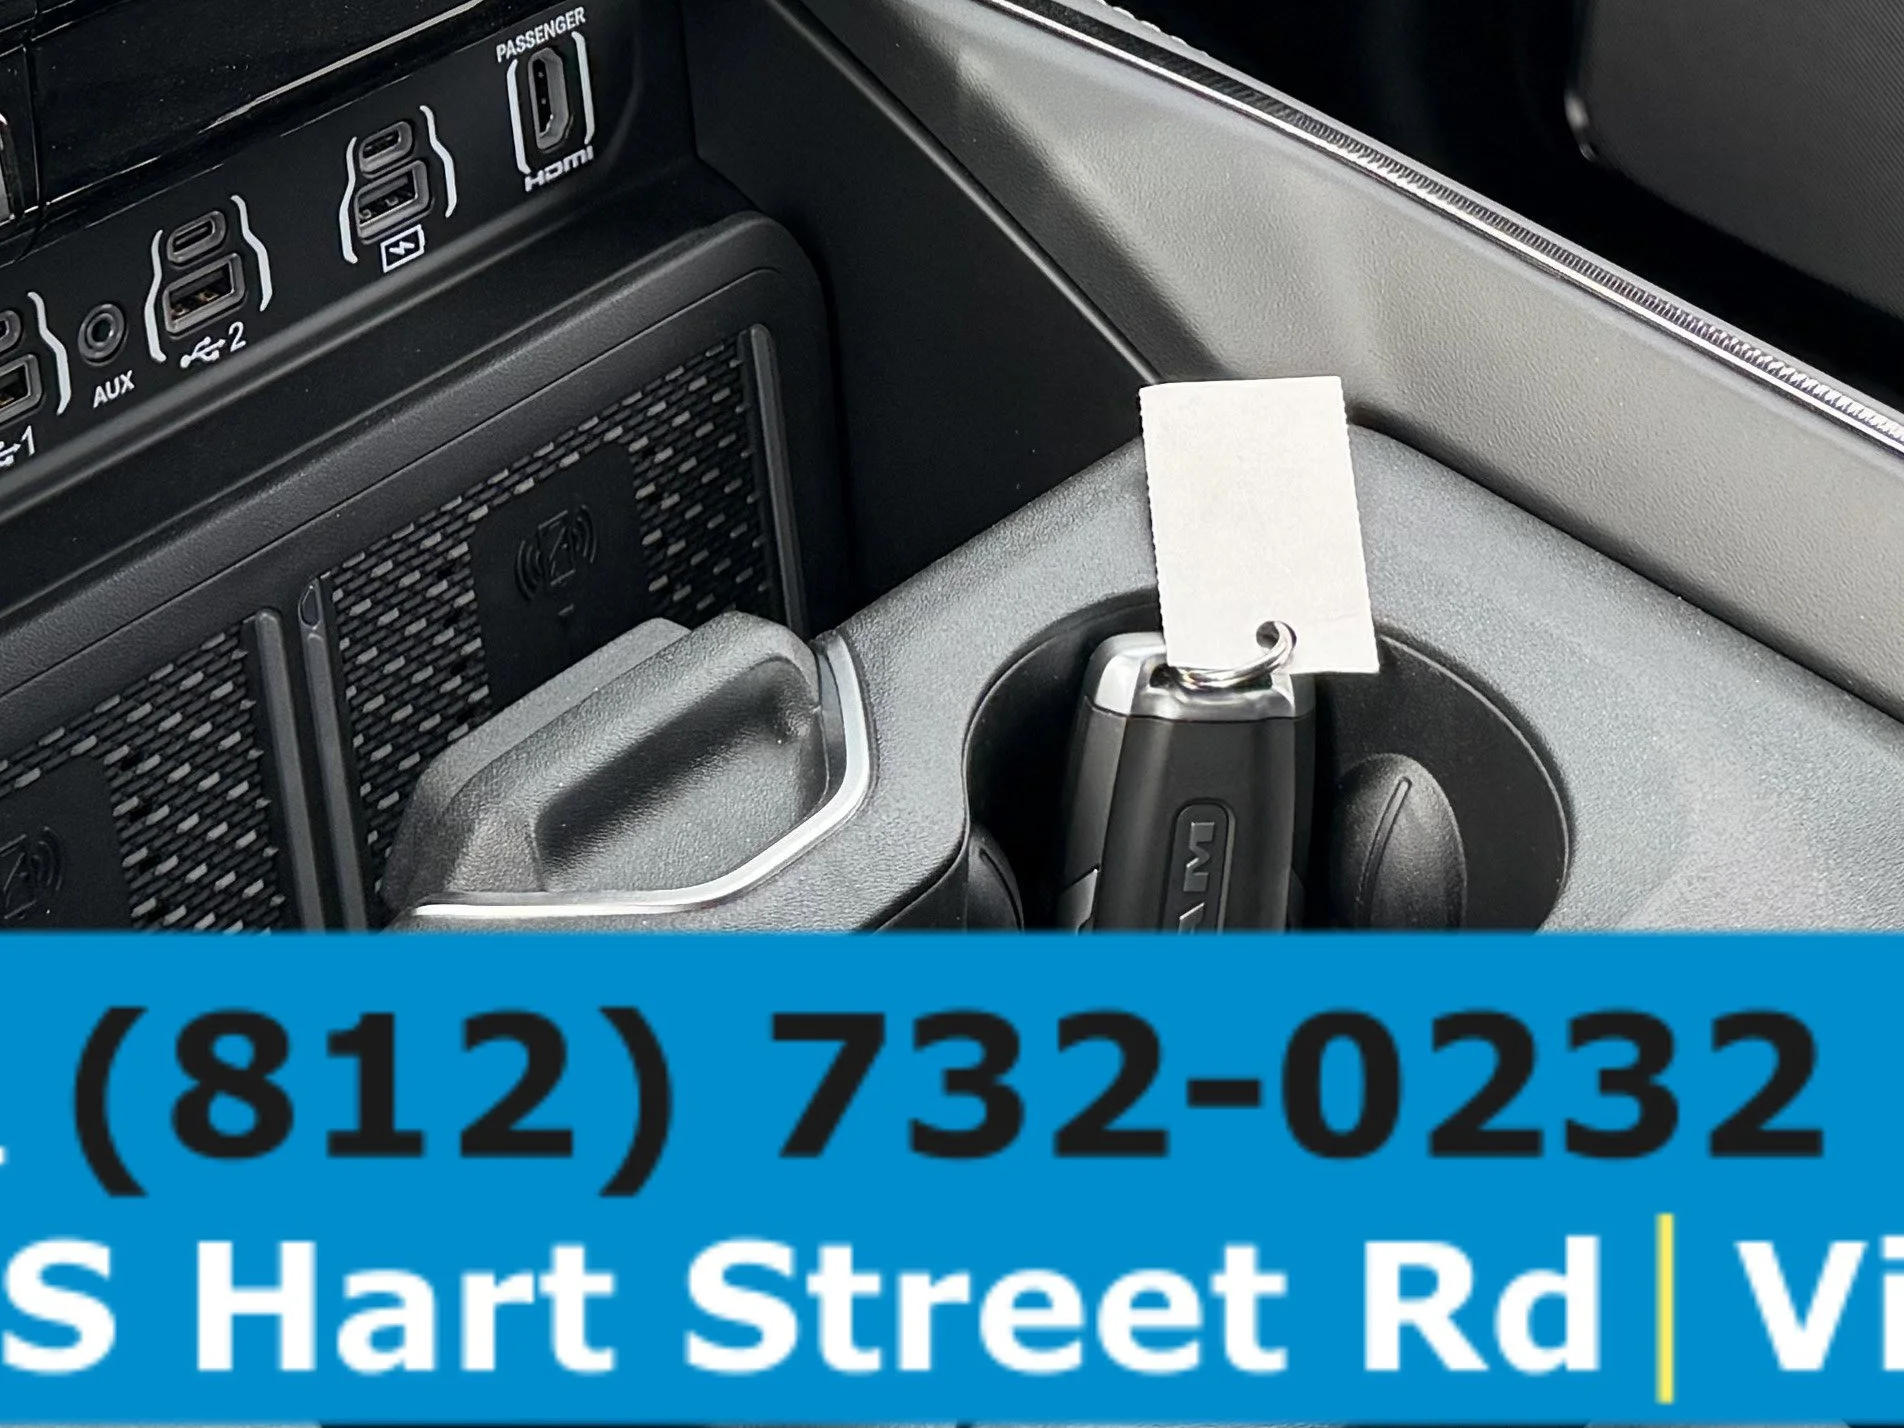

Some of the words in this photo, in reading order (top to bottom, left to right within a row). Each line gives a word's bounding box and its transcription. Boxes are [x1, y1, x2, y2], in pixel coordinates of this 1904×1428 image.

[494, 5, 588, 64] PASSENGER
[523, 144, 596, 193] HDMI
[227, 321, 248, 353] 2
[91, 369, 137, 410] AUX
[18, 425, 37, 459] 1
